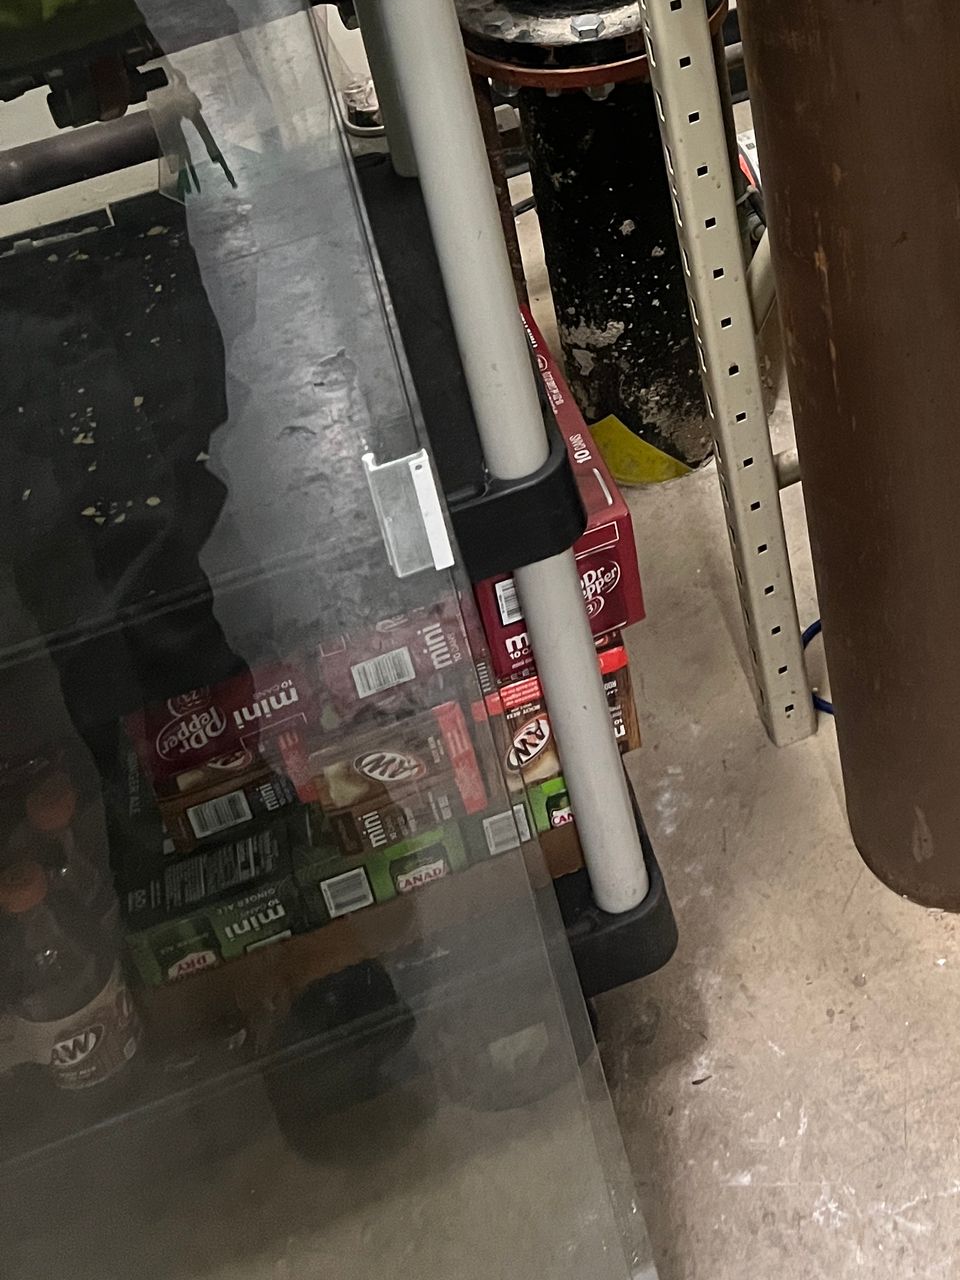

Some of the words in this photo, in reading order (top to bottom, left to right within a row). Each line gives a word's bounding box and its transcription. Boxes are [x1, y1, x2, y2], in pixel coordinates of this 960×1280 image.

[572, 447, 592, 465] 10
[581, 567, 617, 599] epper
[583, 567, 605, 587] Dr
[586, 604, 595, 615] 3
[417, 623, 452, 670] mini
[508, 650, 521, 660] 10
[452, 652, 463, 663] 10
[279, 679, 293, 689] 10
[233, 686, 299, 729] mini
[162, 706, 222, 754] Pepper
[180, 730, 209, 754] Dr
[256, 783, 280, 811] mini
[358, 811, 387, 848] mini
[552, 813, 576, 826] CAN
[238, 887, 276, 908] GINGER
[268, 898, 280, 908] 10
[224, 905, 286, 942] mini
[176, 955, 208, 974] DRY
